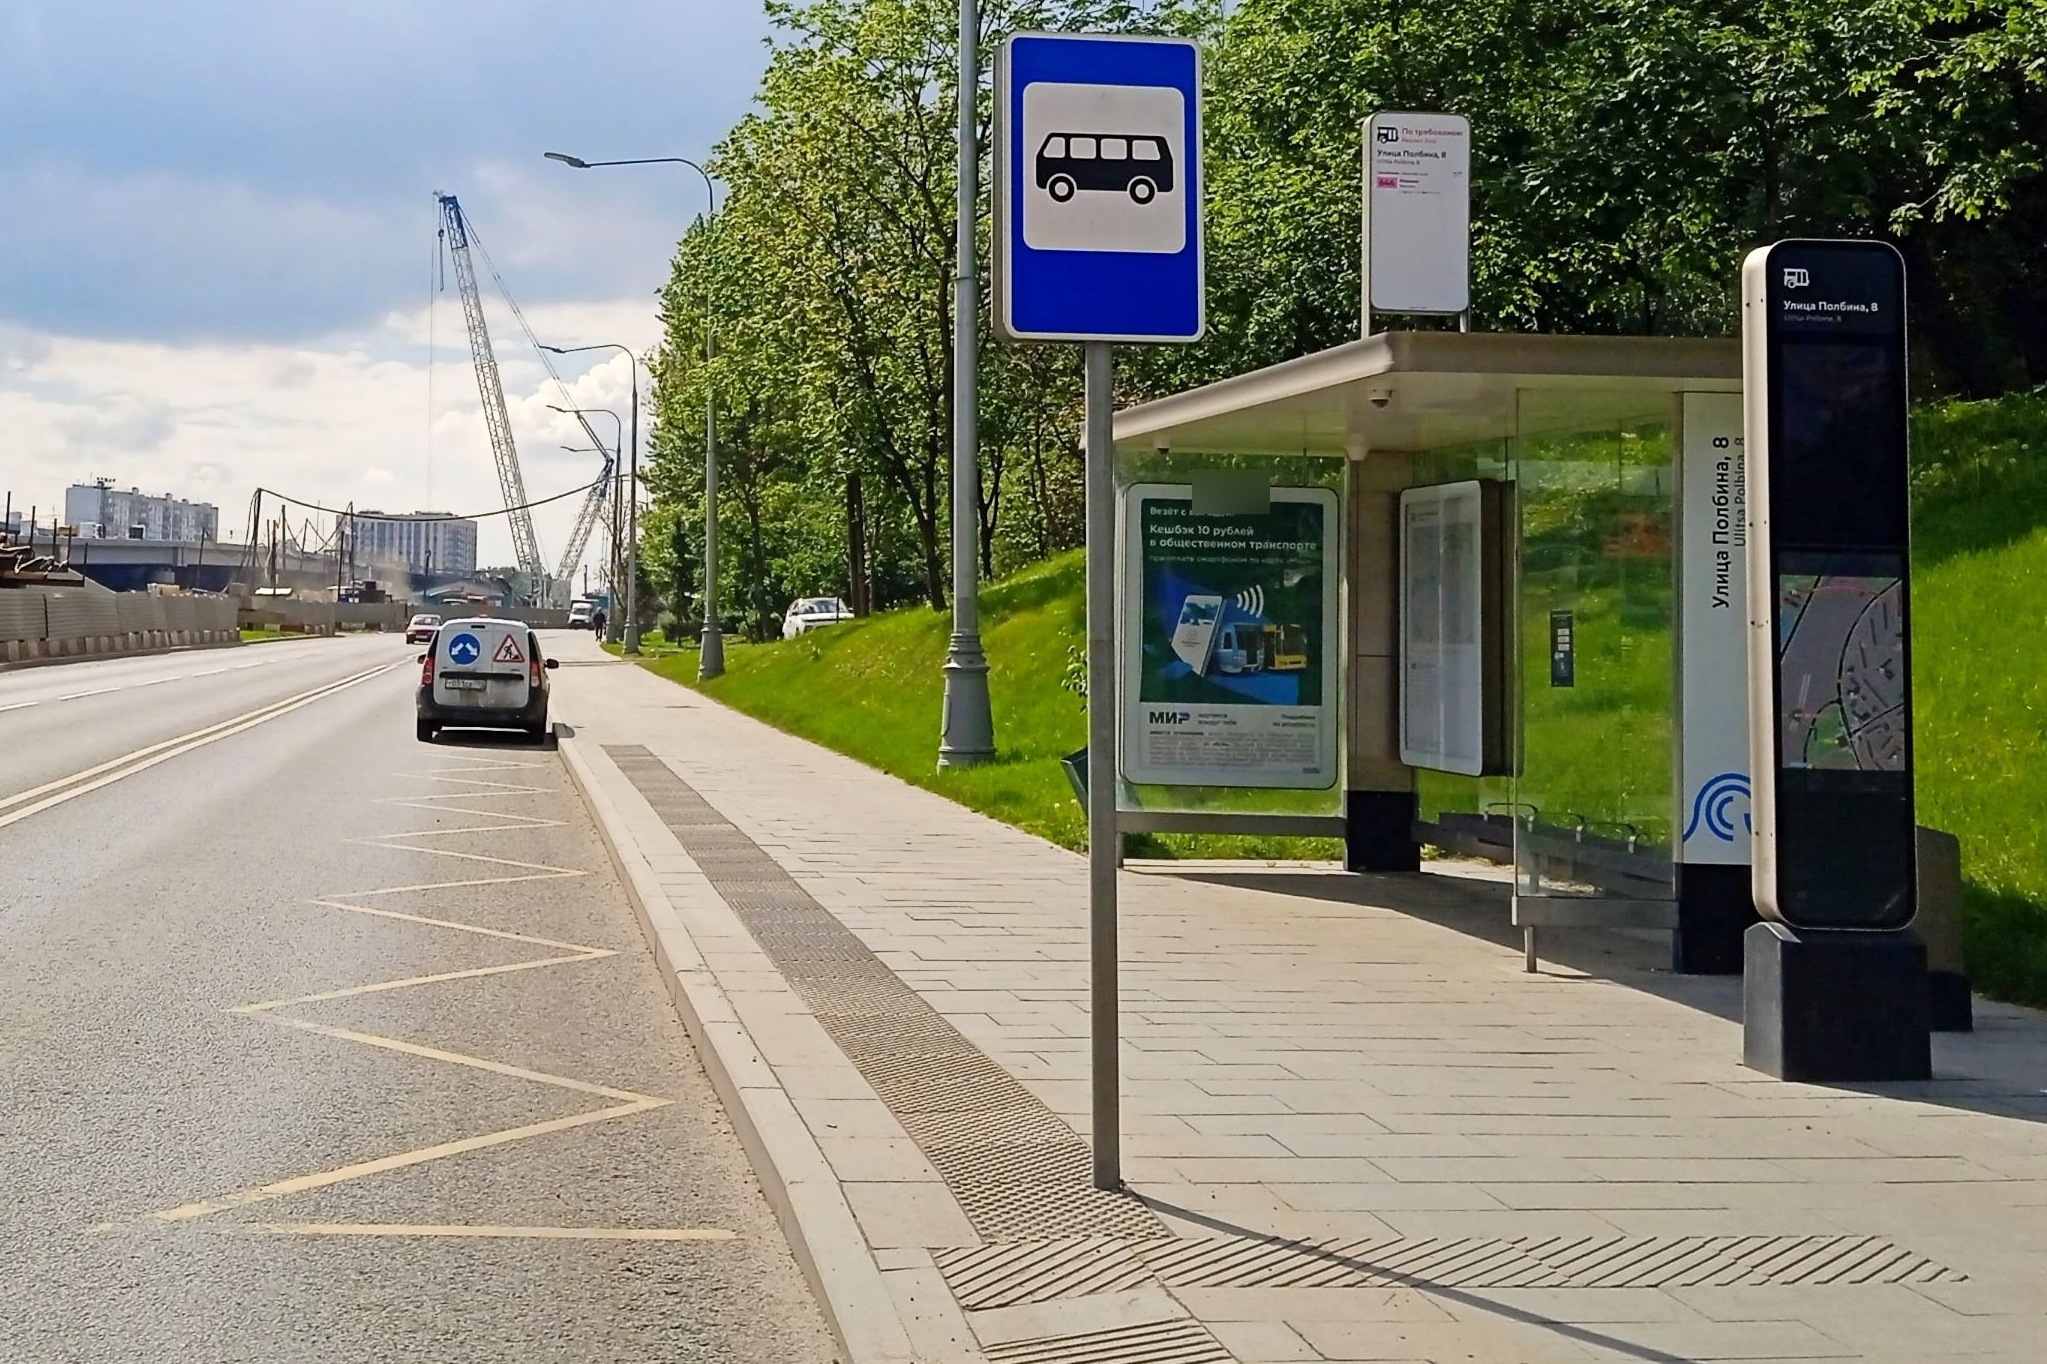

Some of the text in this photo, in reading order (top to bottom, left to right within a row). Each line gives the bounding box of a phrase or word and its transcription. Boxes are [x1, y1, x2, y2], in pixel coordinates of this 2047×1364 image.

[1377, 150, 1401, 158] Улица
[1783, 300, 1878, 312] Улица Полбина, 8
[1712, 436, 1732, 608] Улица Полбина, 8
[1734, 509, 1746, 547] Ulitsa
[1149, 525, 1254, 538] Кешбэк 10 рублей
[1159, 538, 1246, 550] общественном
[1249, 540, 1317, 552] транспорте
[1149, 711, 1190, 725] МИР
